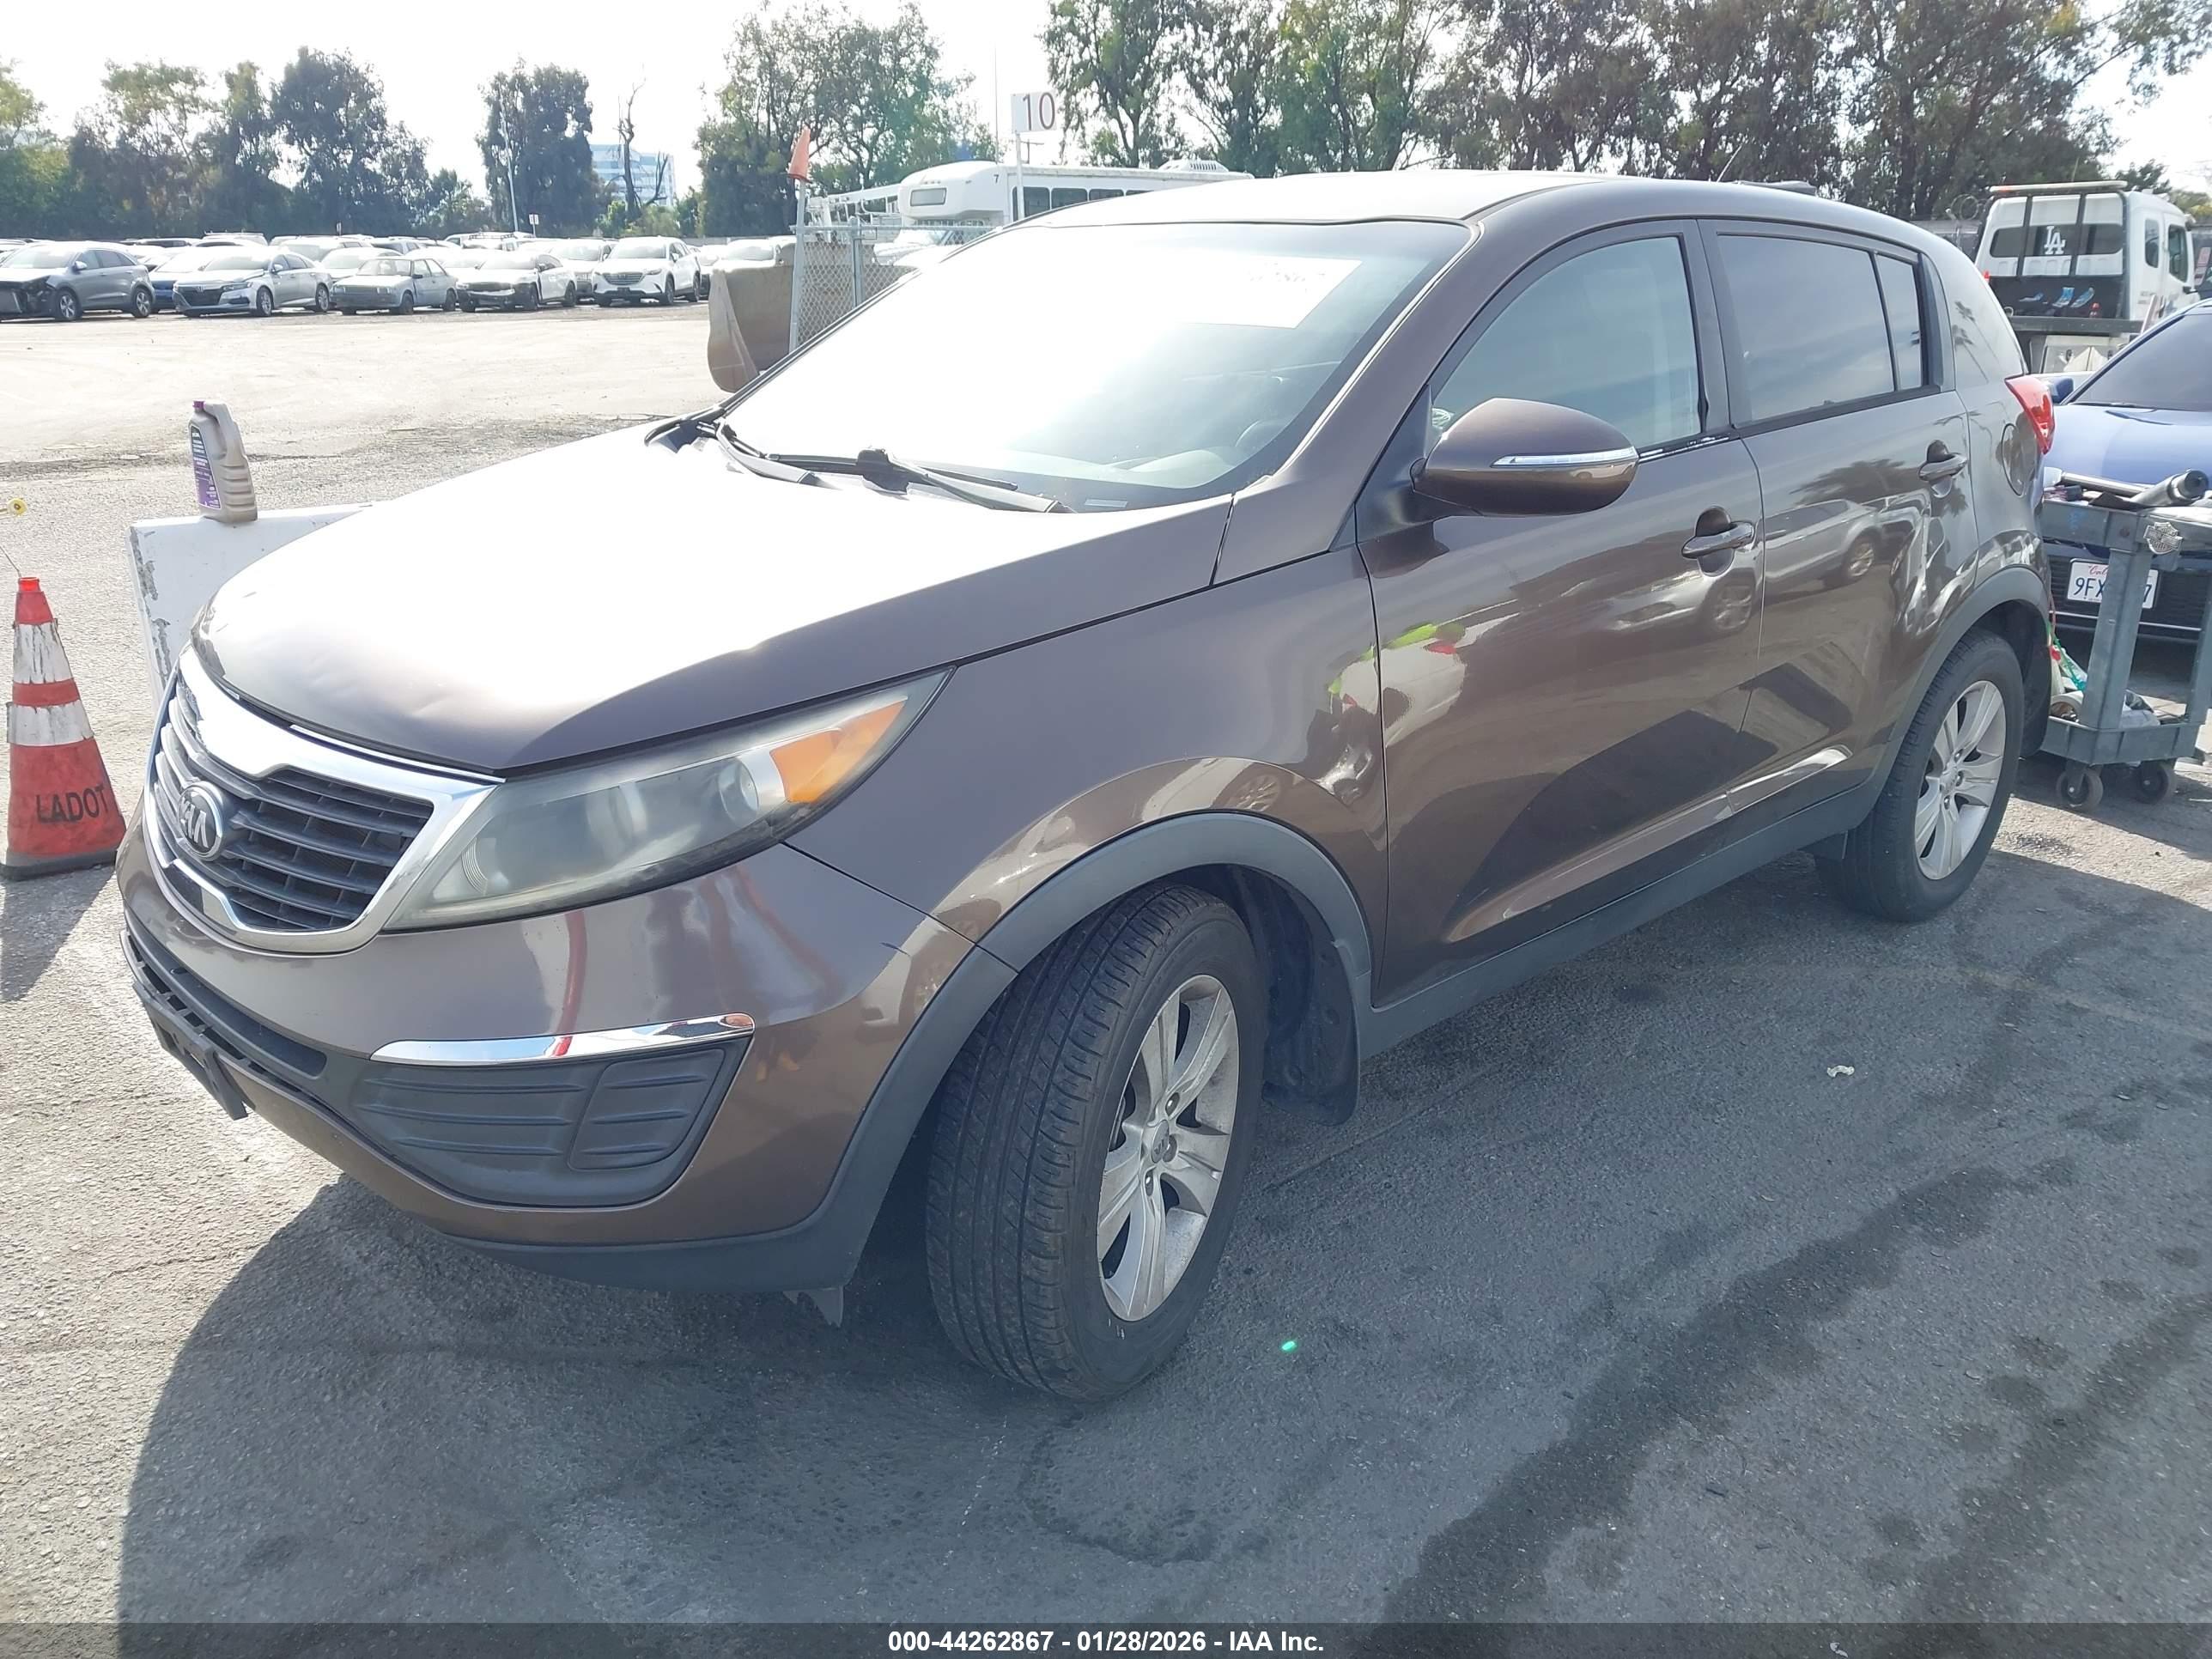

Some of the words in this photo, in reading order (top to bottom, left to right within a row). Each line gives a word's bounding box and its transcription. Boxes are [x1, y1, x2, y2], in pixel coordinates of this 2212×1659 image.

[1023, 92, 1055, 131] 10
[994, 173, 1000, 184] 7
[2044, 225, 2066, 255] LA
[35, 784, 109, 823] LADOT
